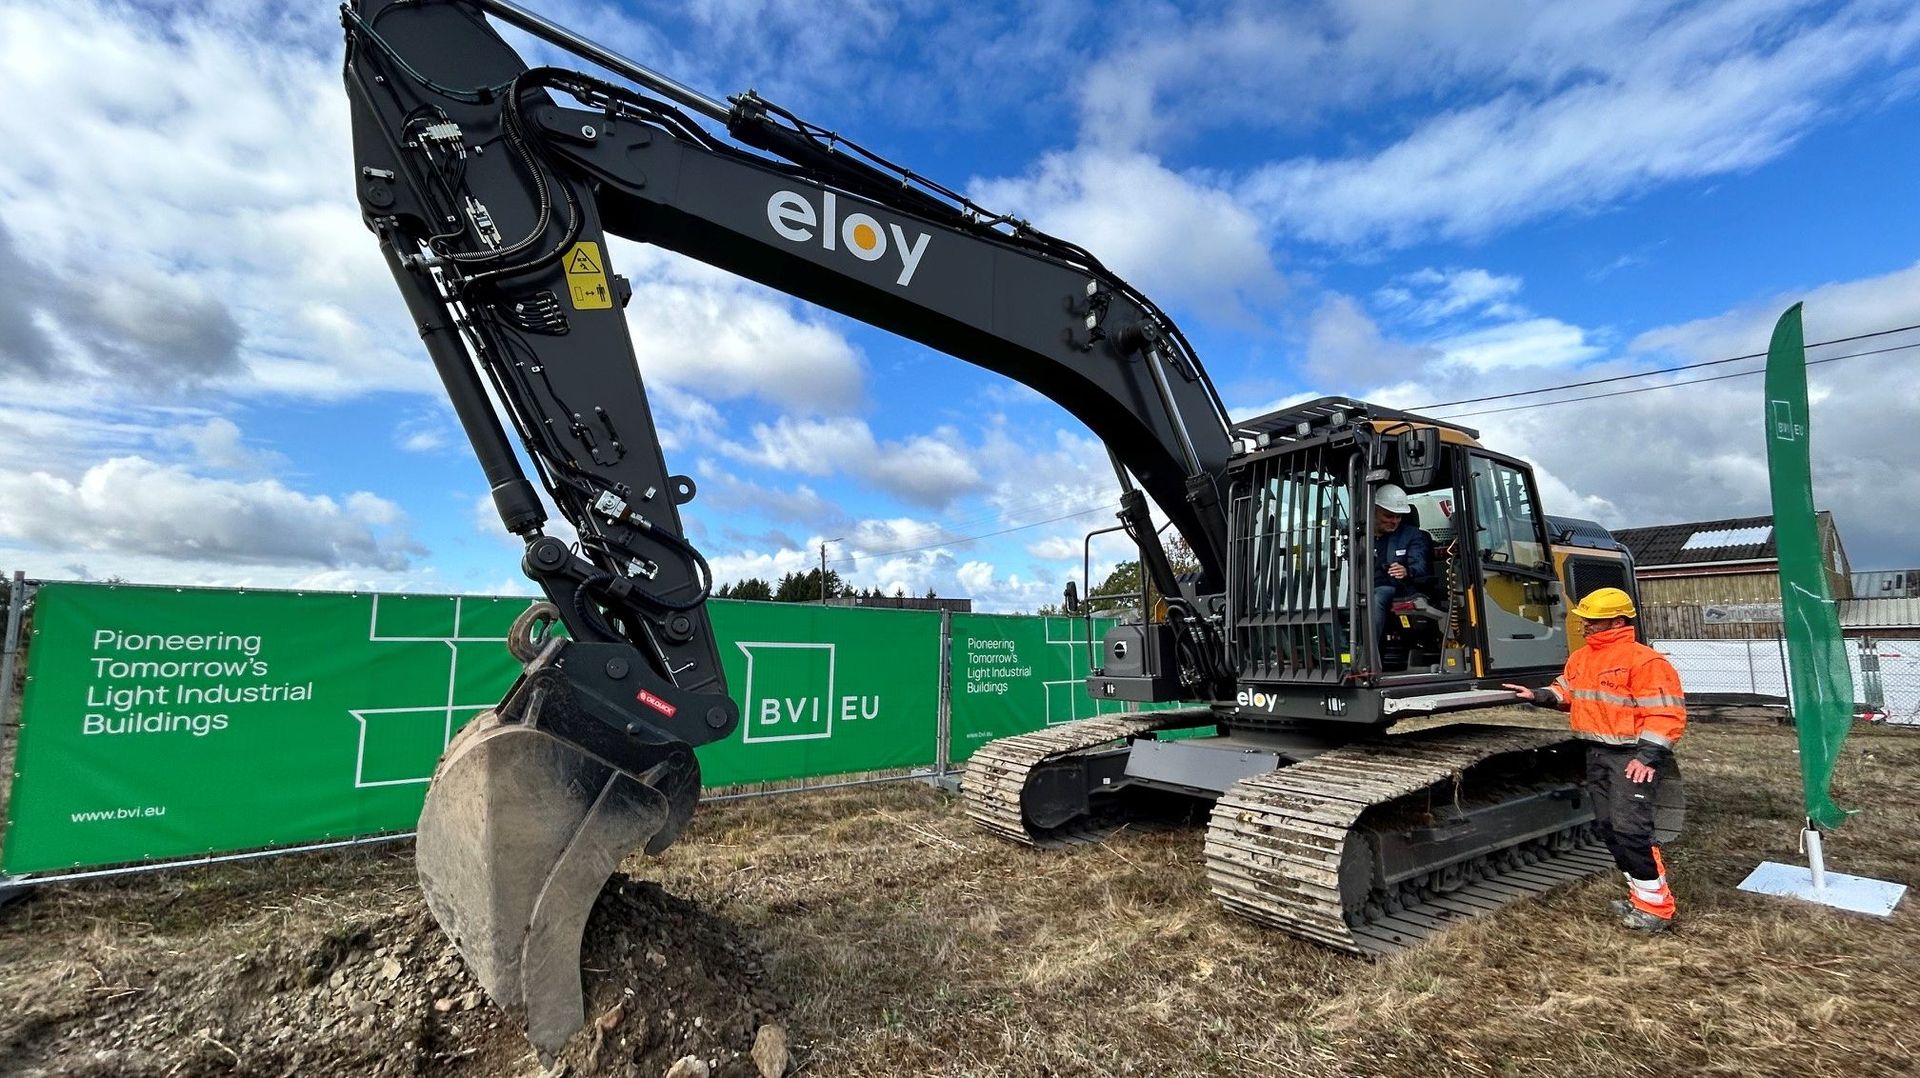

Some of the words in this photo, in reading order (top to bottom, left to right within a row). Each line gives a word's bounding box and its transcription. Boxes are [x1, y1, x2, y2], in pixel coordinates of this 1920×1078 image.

[767, 190, 932, 287] eloy
[93, 629, 262, 656] Pioneering
[967, 637, 1015, 652] Pioneering
[90, 657, 268, 678] Tomorrow’s
[967, 652, 1018, 664] Tomorrow’s
[967, 667, 991, 682] Light
[991, 665, 1032, 678] Industrial
[87, 685, 170, 712] Light
[176, 681, 313, 705] Industrial
[967, 681, 1009, 695] Buildings
[760, 697, 819, 725] BVI
[841, 695, 879, 721] EU
[1236, 687, 1278, 713] eloy
[83, 712, 230, 737] Buildings
[71, 806, 166, 823] www.bvi.eu
